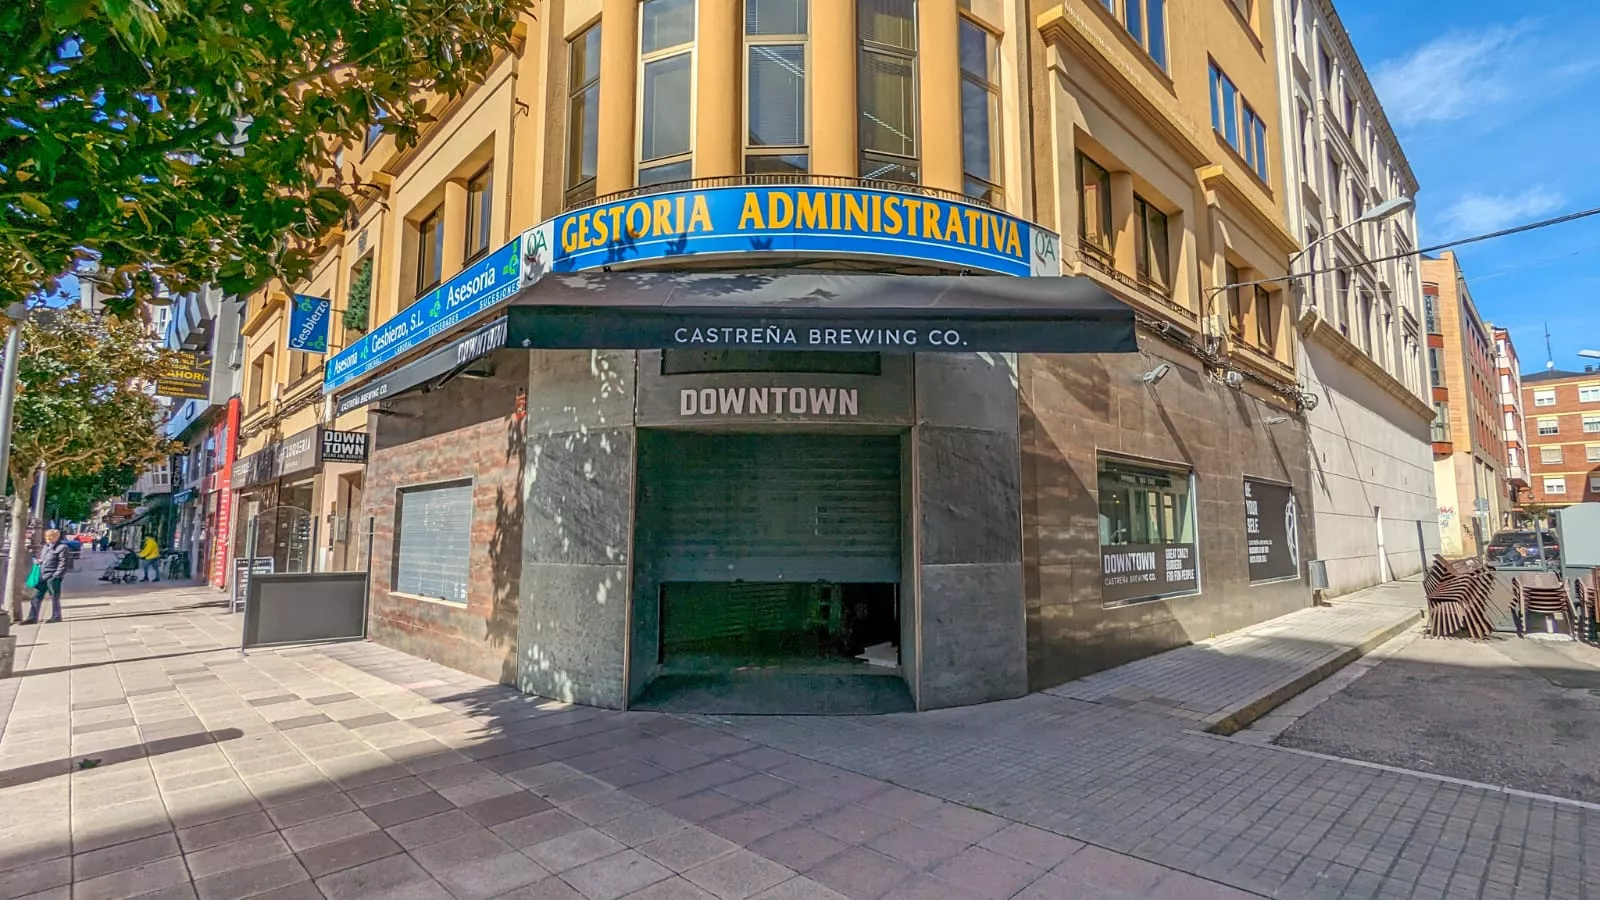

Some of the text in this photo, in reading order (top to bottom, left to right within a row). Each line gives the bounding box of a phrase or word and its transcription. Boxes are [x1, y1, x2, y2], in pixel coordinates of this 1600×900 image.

[562, 191, 1022, 258] GESTORIA ADMINISTRATIVA
[479, 281, 520, 309] SUCESIONES
[291, 300, 329, 348] Gesbierzo
[334, 348, 358, 375] Asesoría
[371, 321, 408, 352] Gesbierzo,
[446, 263, 496, 310] Asesoría
[674, 325, 968, 346] CASTREÑA BREWING CO.
[680, 387, 858, 416] DOWNTOWN
[323, 442, 364, 455] TOWN
[324, 431, 365, 444] DOWN
[1104, 552, 1155, 574] DOWNTOWN
